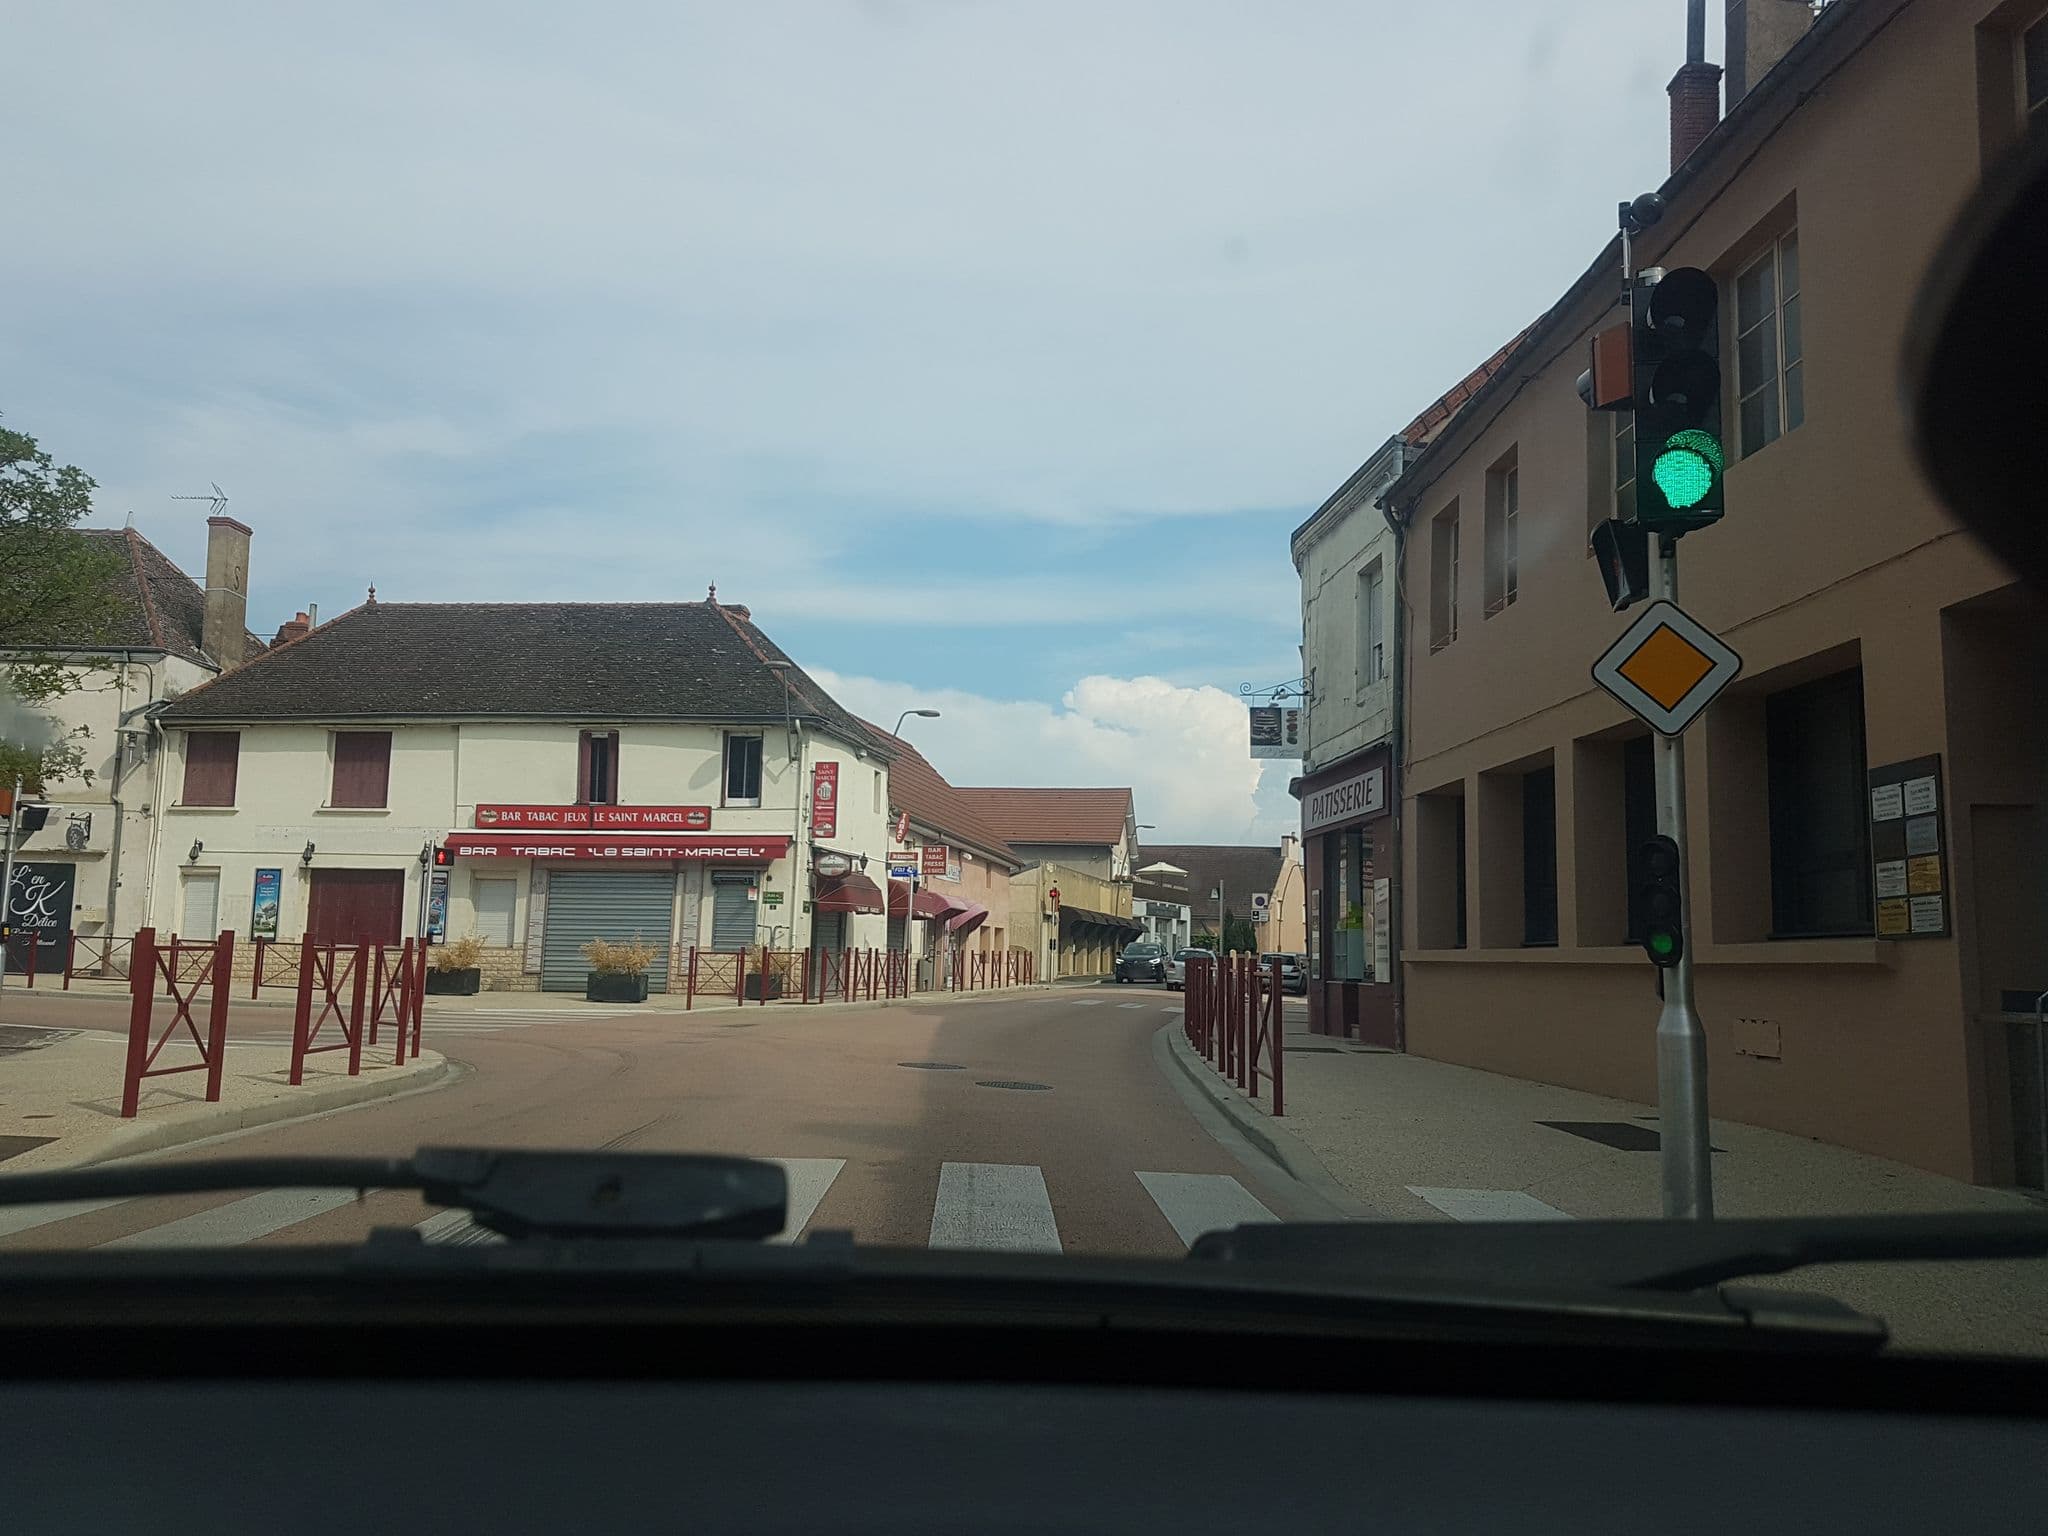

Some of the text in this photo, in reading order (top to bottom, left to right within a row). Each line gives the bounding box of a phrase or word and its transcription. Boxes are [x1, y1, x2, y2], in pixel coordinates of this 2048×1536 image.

[1311, 776, 1374, 823] PATISSERIE
[501, 811, 521, 822] BAR
[527, 811, 559, 822] TABAC
[563, 812, 587, 823] JEUX
[594, 812, 605, 823] LE
[608, 812, 639, 823] SAINT
[642, 812, 684, 823] MARCEL
[459, 846, 497, 856] BAR
[511, 847, 577, 857] TABAC
[10, 881, 66, 916] K
